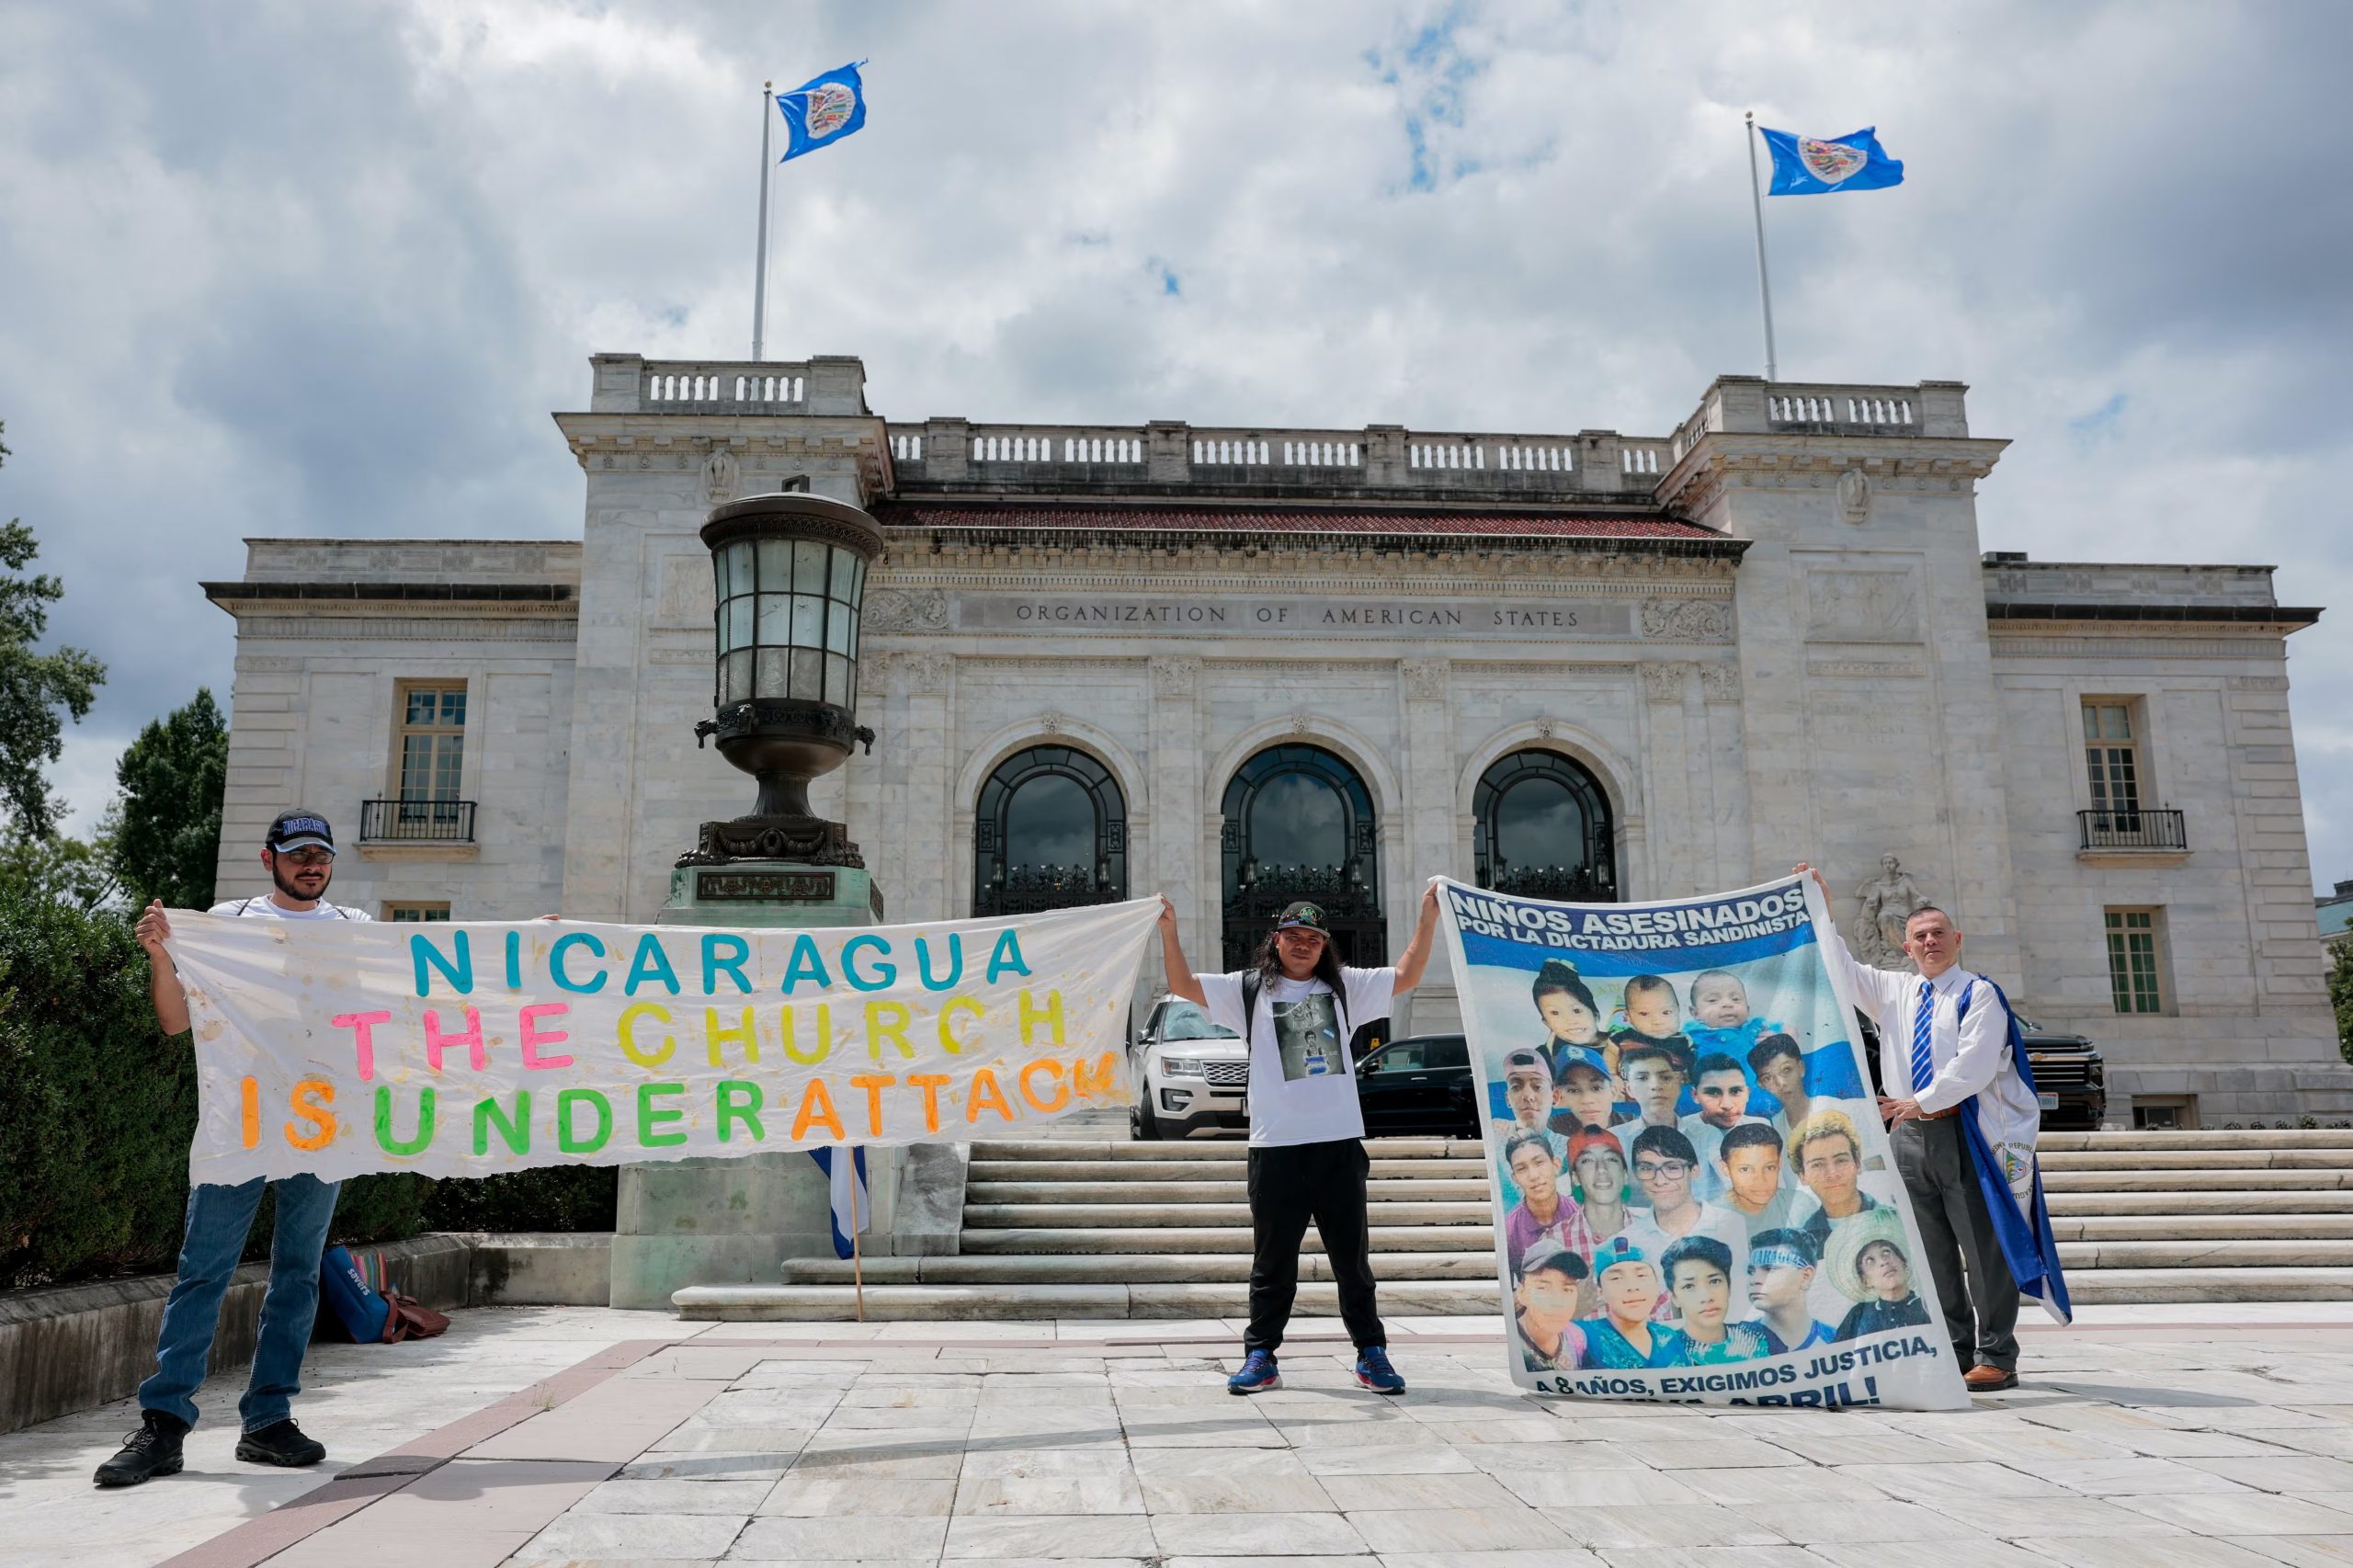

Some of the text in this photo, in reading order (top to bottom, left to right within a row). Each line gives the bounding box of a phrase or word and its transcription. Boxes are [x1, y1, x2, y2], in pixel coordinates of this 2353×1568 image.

[1017, 605, 1578, 627] ORGANIZATION OF AMERICAN STATES
[1449, 888, 1805, 936] NIÑOS ASESINADOS
[1456, 910, 1811, 950] POR LA DICTADURA SANDINISTA
[410, 928, 1033, 998] NICARAGUA
[331, 988, 1065, 1082] THE CHURCH
[241, 1075, 338, 1153] IS
[374, 1079, 766, 1156] UNDER
[347, 1268, 370, 1296] savers
[1555, 1376, 1574, 1395] 8
[1660, 1364, 1798, 1393] EXIGIMOS
[1803, 1335, 1938, 1380] JUSTICIA,
